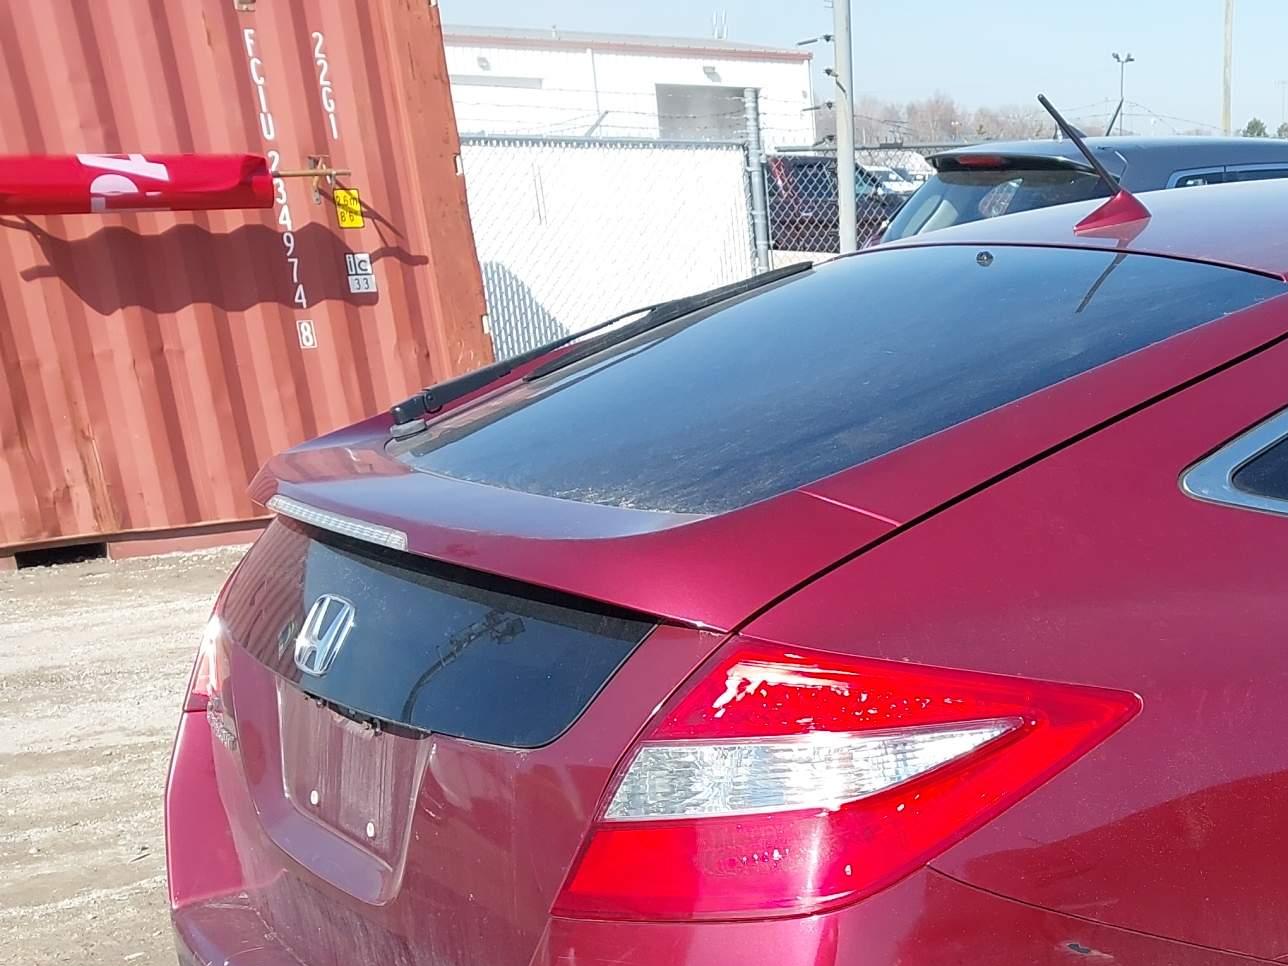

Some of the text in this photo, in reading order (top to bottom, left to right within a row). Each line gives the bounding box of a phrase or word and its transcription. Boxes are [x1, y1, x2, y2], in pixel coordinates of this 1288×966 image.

[311, 31, 338, 140] 22G1
[244, 28, 275, 140] FCIU
[267, 150, 307, 309] 234974
[354, 277, 370, 290] 33
